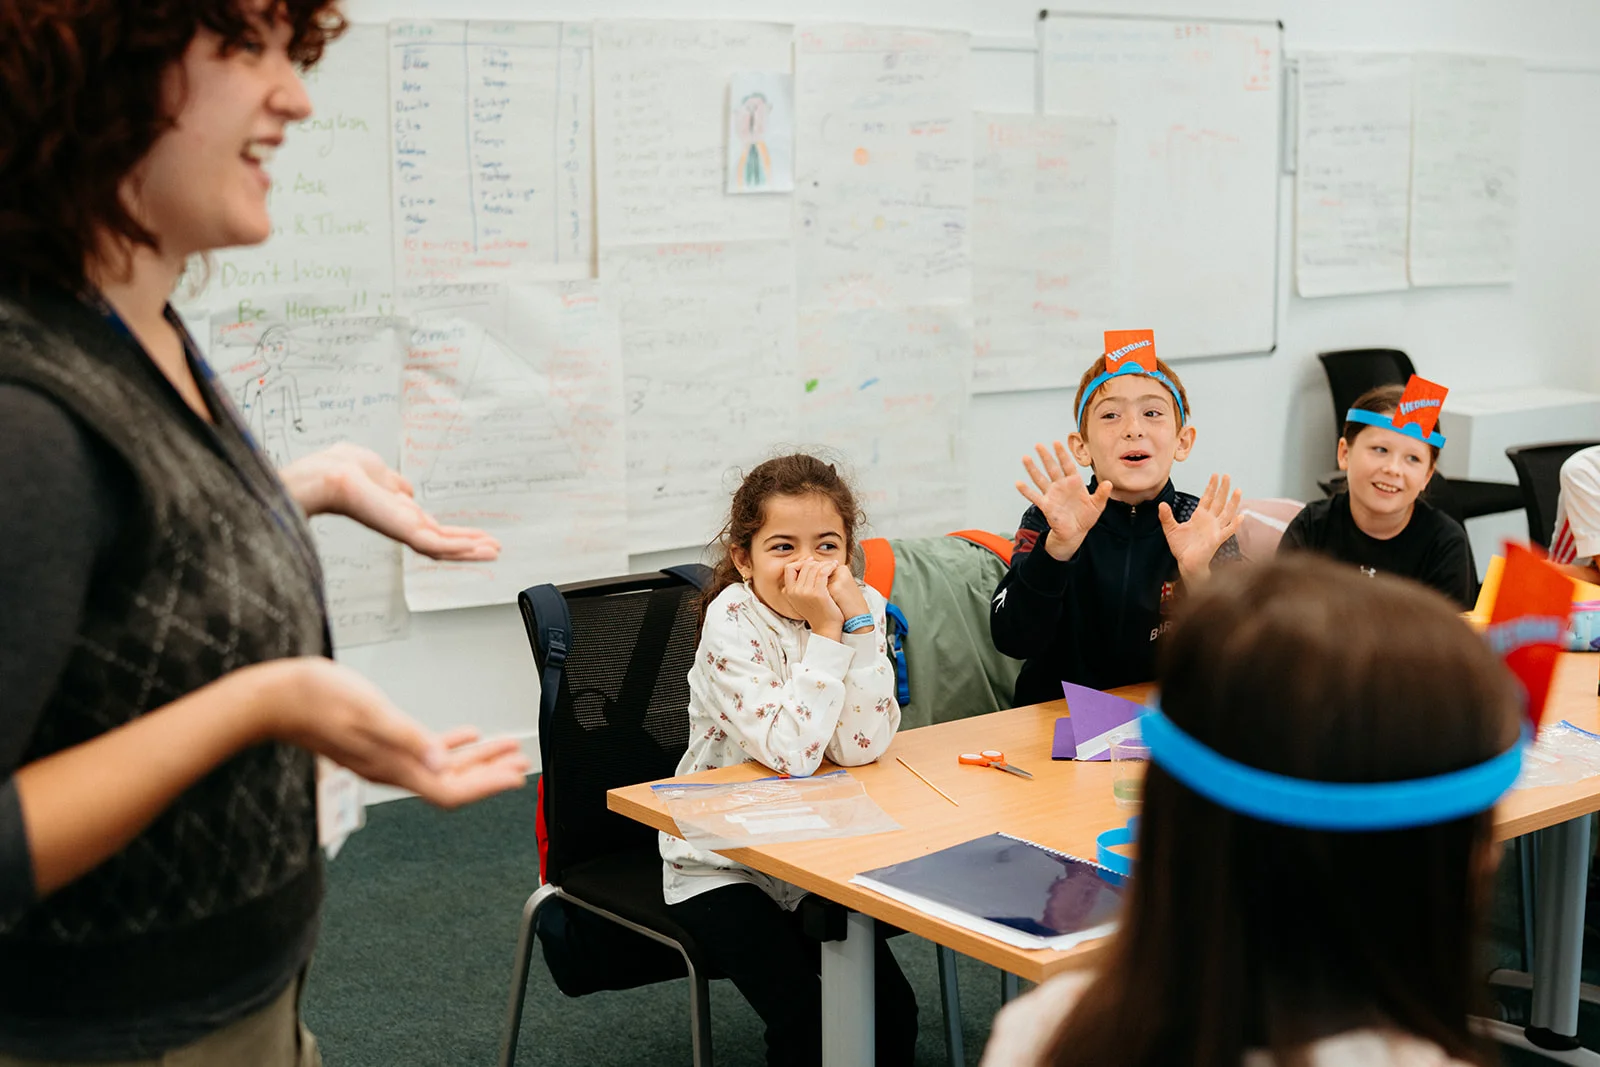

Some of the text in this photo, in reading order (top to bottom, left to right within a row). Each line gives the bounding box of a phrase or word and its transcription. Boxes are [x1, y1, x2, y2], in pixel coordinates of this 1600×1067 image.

[293, 171, 328, 197] Ask
[221, 258, 281, 289] Don't
[238, 298, 267, 323] Be
[1106, 339, 1152, 362] HEDBANZ
[1149, 620, 1173, 642] BAR
